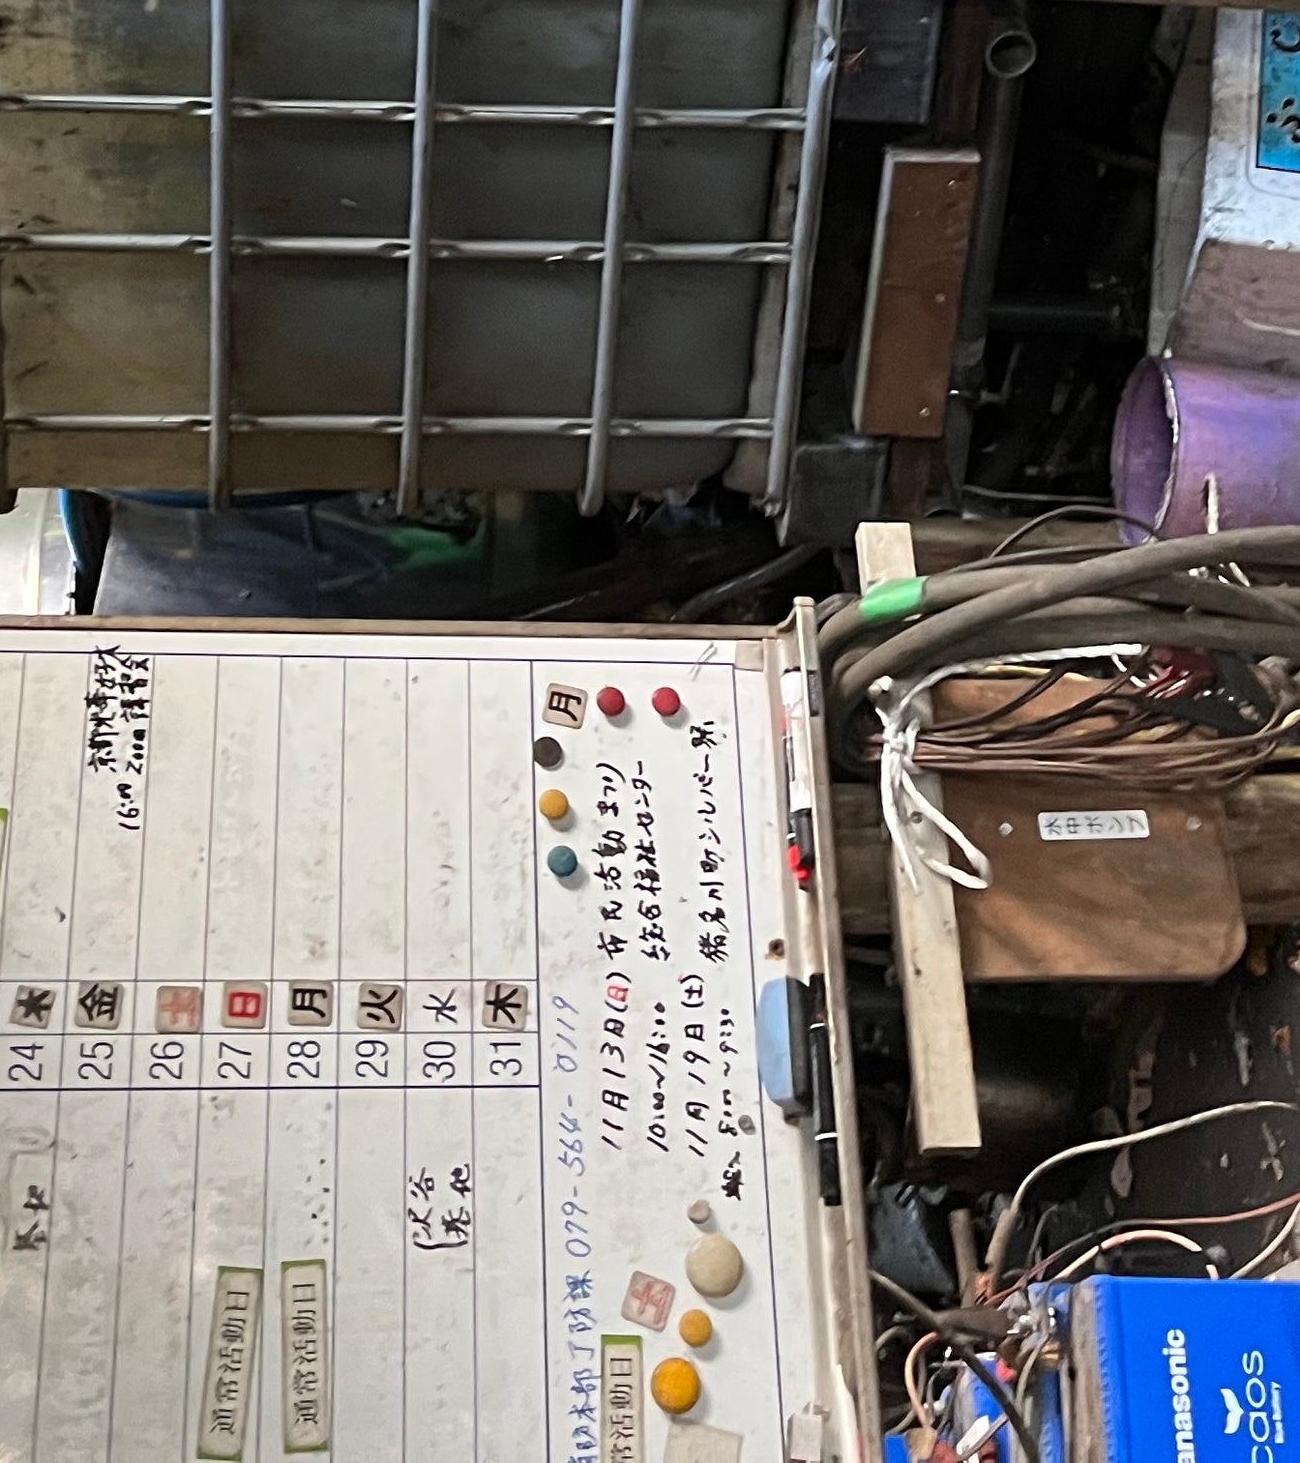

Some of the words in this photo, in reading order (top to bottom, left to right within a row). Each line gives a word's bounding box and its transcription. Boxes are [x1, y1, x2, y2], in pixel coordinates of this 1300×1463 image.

[547, 689, 582, 722] 月
[1044, 814, 1146, 836] 水中ポンプ
[14, 987, 52, 1025] 木
[80, 984, 120, 1023] 金
[162, 987, 200, 1028] 土
[227, 990, 262, 1020] 日
[291, 985, 329, 1017] 月
[359, 983, 399, 1024] 火
[423, 992, 459, 1023] 水
[486, 982, 524, 1026] 木
[8, 1040, 46, 1082] 24
[79, 1040, 114, 1080] 25
[149, 1040, 186, 1080] 26
[218, 1040, 253, 1080] 27
[288, 1039, 323, 1079] 28
[355, 1038, 392, 1079] 29
[422, 1039, 458, 1080] 30
[489, 1038, 525, 1077] 31
[209, 1289, 251, 1435] 通常活動日
[291, 1281, 319, 1425] 通常活動日
